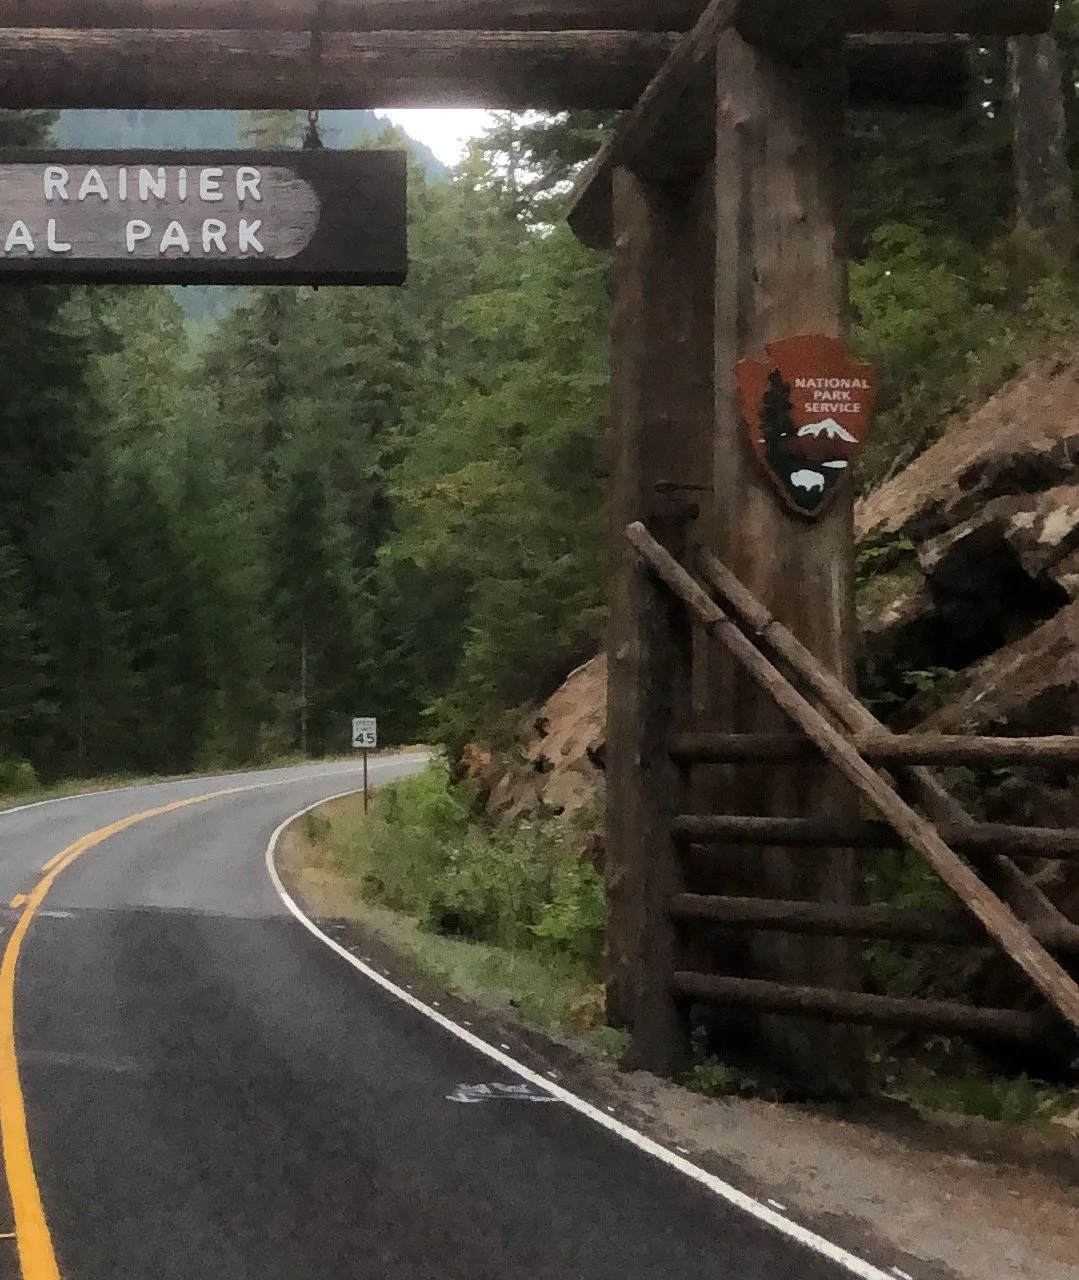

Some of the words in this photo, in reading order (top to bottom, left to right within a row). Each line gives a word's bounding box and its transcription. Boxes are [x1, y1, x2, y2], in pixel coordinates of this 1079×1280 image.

[43, 166, 262, 201] RAINIER
[126, 218, 265, 253] PARK
[794, 377, 870, 389] NATIONAL
[813, 390, 852, 401] PARK
[804, 402, 862, 413] SERVICE
[355, 732, 375, 744] 45
